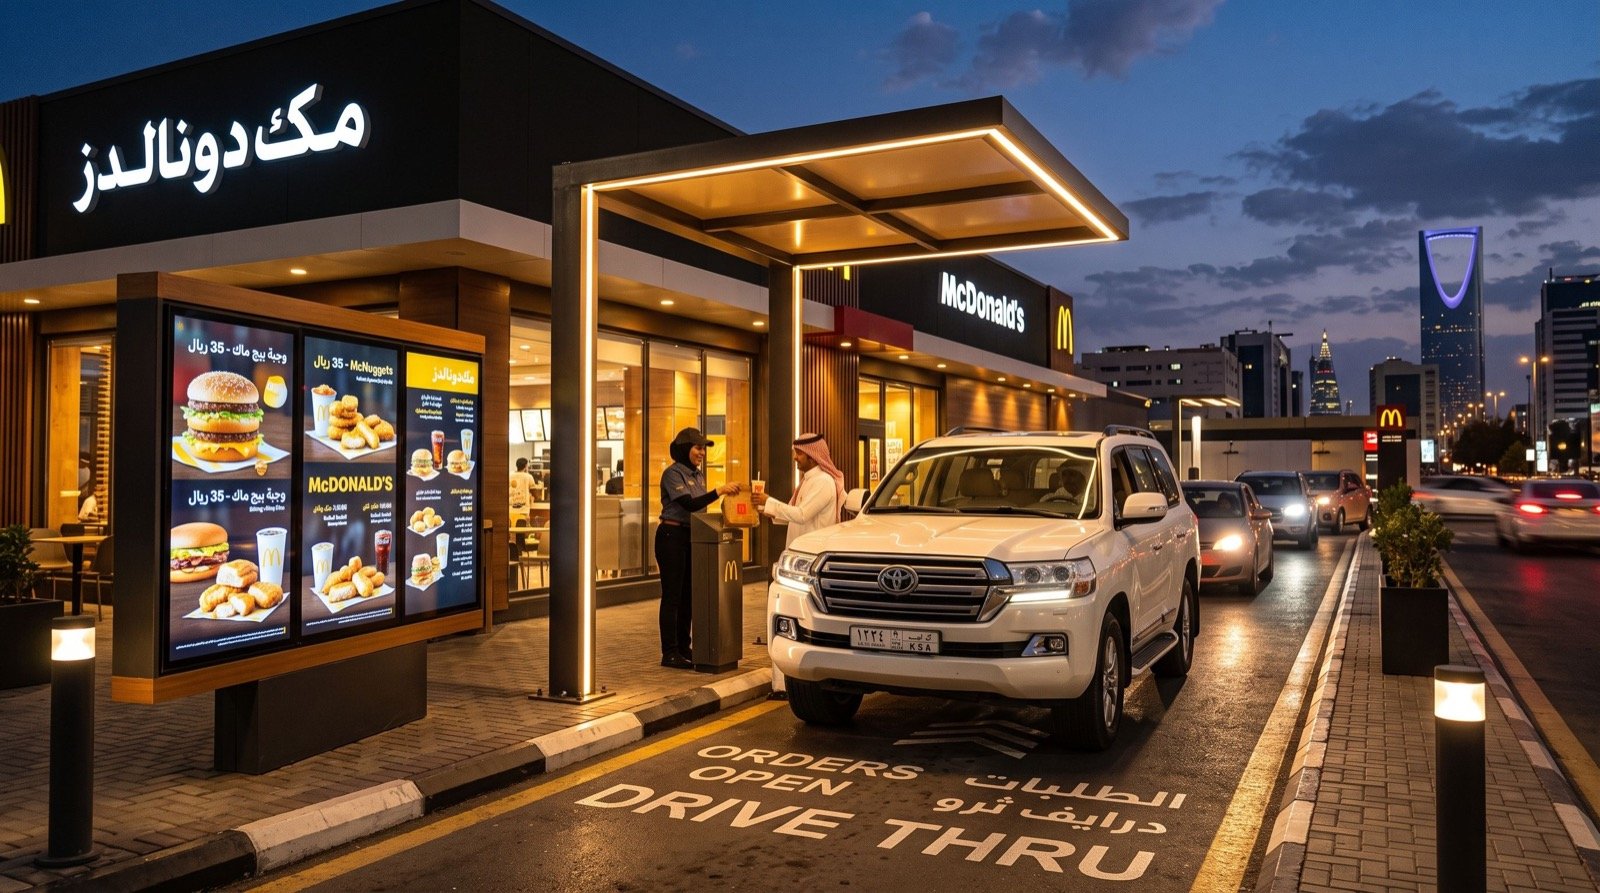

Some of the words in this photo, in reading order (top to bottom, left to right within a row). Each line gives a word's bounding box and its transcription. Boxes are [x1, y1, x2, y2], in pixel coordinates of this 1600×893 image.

[941, 271, 1025, 333] McDonald's
[188, 338, 208, 355] ريال
[210, 340, 225, 354] 35
[232, 344, 250, 357] ماك
[267, 347, 287, 364] وجبة
[313, 354, 331, 370] ريال
[332, 356, 343, 369] 35
[350, 359, 393, 377] McNuggets
[308, 476, 393, 493] McDONALD'S
[188, 490, 209, 506] ريال
[210, 489, 225, 503] 35
[231, 489, 249, 502] ماك
[266, 487, 286, 503] وجبة
[697, 745, 925, 780] ORDERS
[689, 766, 853, 796] OPEN
[964, 774, 1187, 809] الطلبات
[1020, 806, 1167, 834] درايف
[573, 783, 855, 840] DRIVE
[876, 818, 1155, 881] THRU
